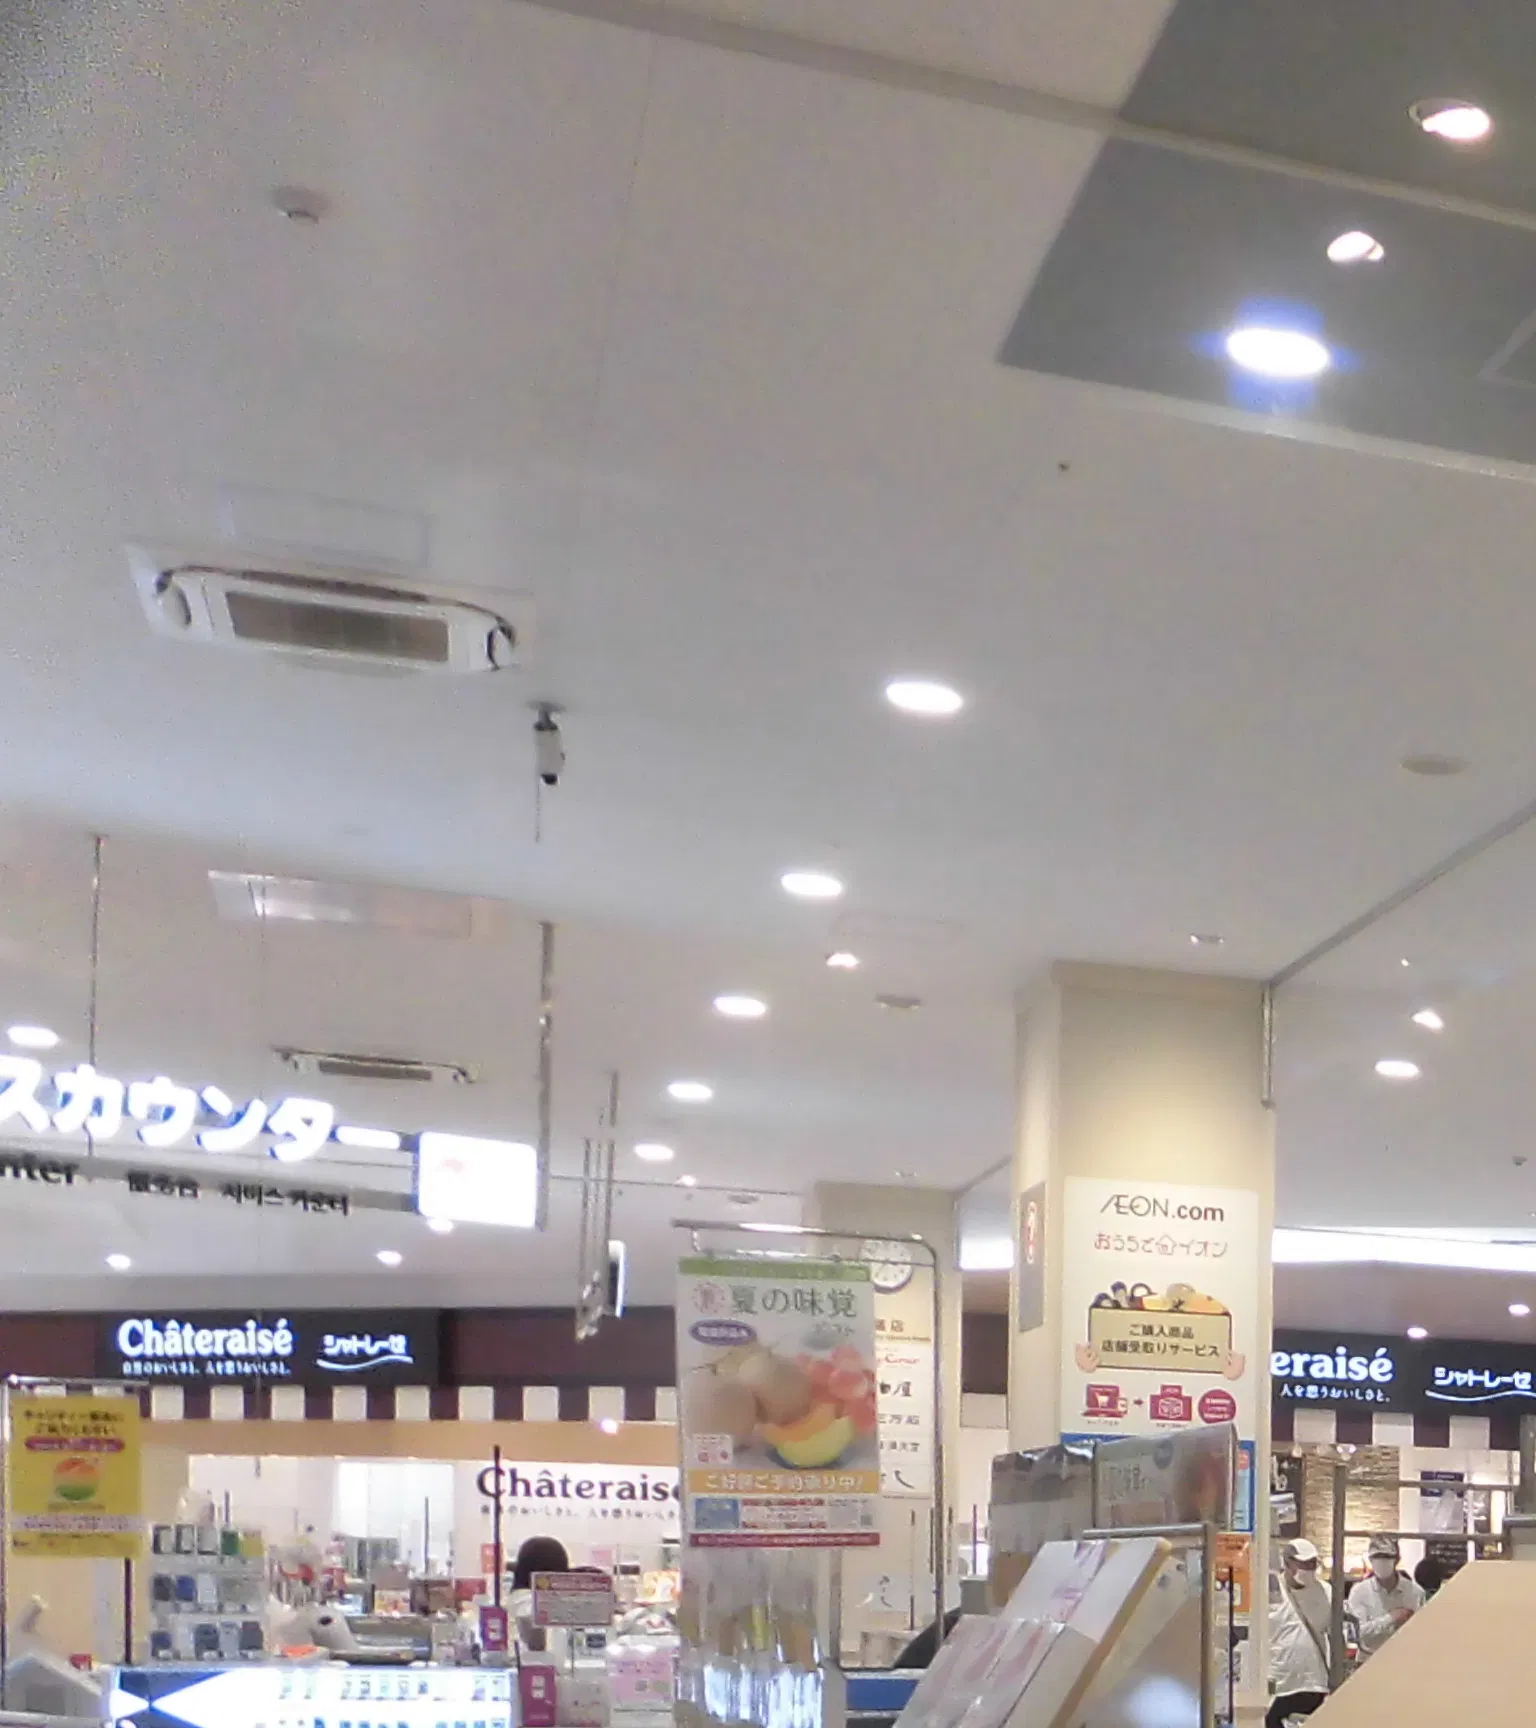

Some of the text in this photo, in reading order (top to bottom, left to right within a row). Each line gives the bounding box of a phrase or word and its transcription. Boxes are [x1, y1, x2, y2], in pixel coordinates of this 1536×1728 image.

[0, 1055, 401, 1162] スカウンター
[728, 1285, 858, 1318] 夏の味覚
[117, 1318, 293, 1357] Châteraisé
[1129, 1323, 1195, 1340] ご購入商品
[1101, 1340, 1221, 1358] 店舗受取りサービス
[1434, 1366, 1532, 1390] シャトレーゼ
